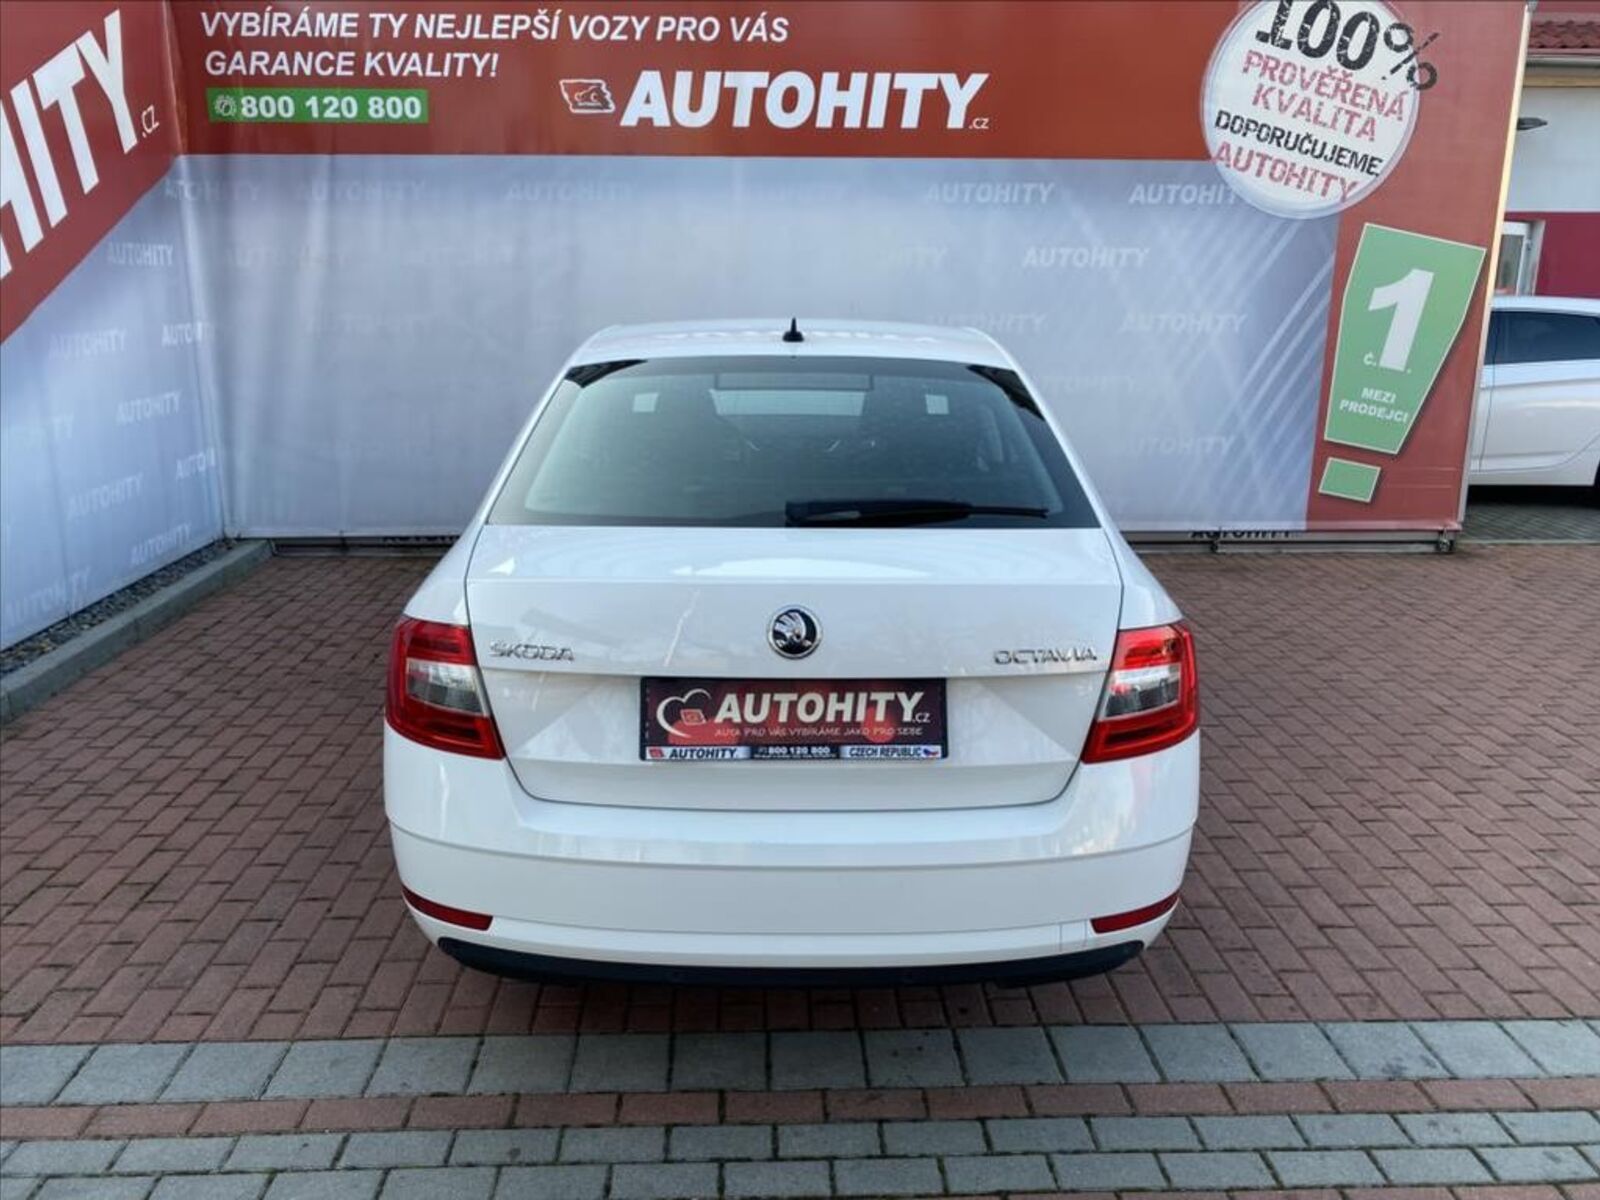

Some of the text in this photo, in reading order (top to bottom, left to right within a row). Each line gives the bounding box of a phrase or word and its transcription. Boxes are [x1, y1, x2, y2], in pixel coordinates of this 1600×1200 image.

[201, 6, 789, 43] VYBÍRÁME TY NEJLEPŠÍ VOZY PRO VÁS
[1255, 0, 1439, 91] 100%
[205, 50, 499, 77] GARANCE KVALITY!
[1242, 49, 1409, 121] PROVĚŘENÁ
[241, 95, 422, 119] 800 120 800
[1252, 83, 1376, 141] KVALITA
[1212, 140, 1358, 201] AUTOHITY
[926, 181, 1055, 203] AUTOHITY
[108, 243, 174, 267] AUTOHITY
[1021, 245, 1150, 269] AUTOHITY
[115, 389, 183, 426] AUTOHITY
[1361, 387, 1397, 404] MEZI
[1339, 399, 1409, 423] PRODEJCI
[993, 647, 1098, 665] OCTAVIA
[669, 748, 737, 758] AUTOHITY
